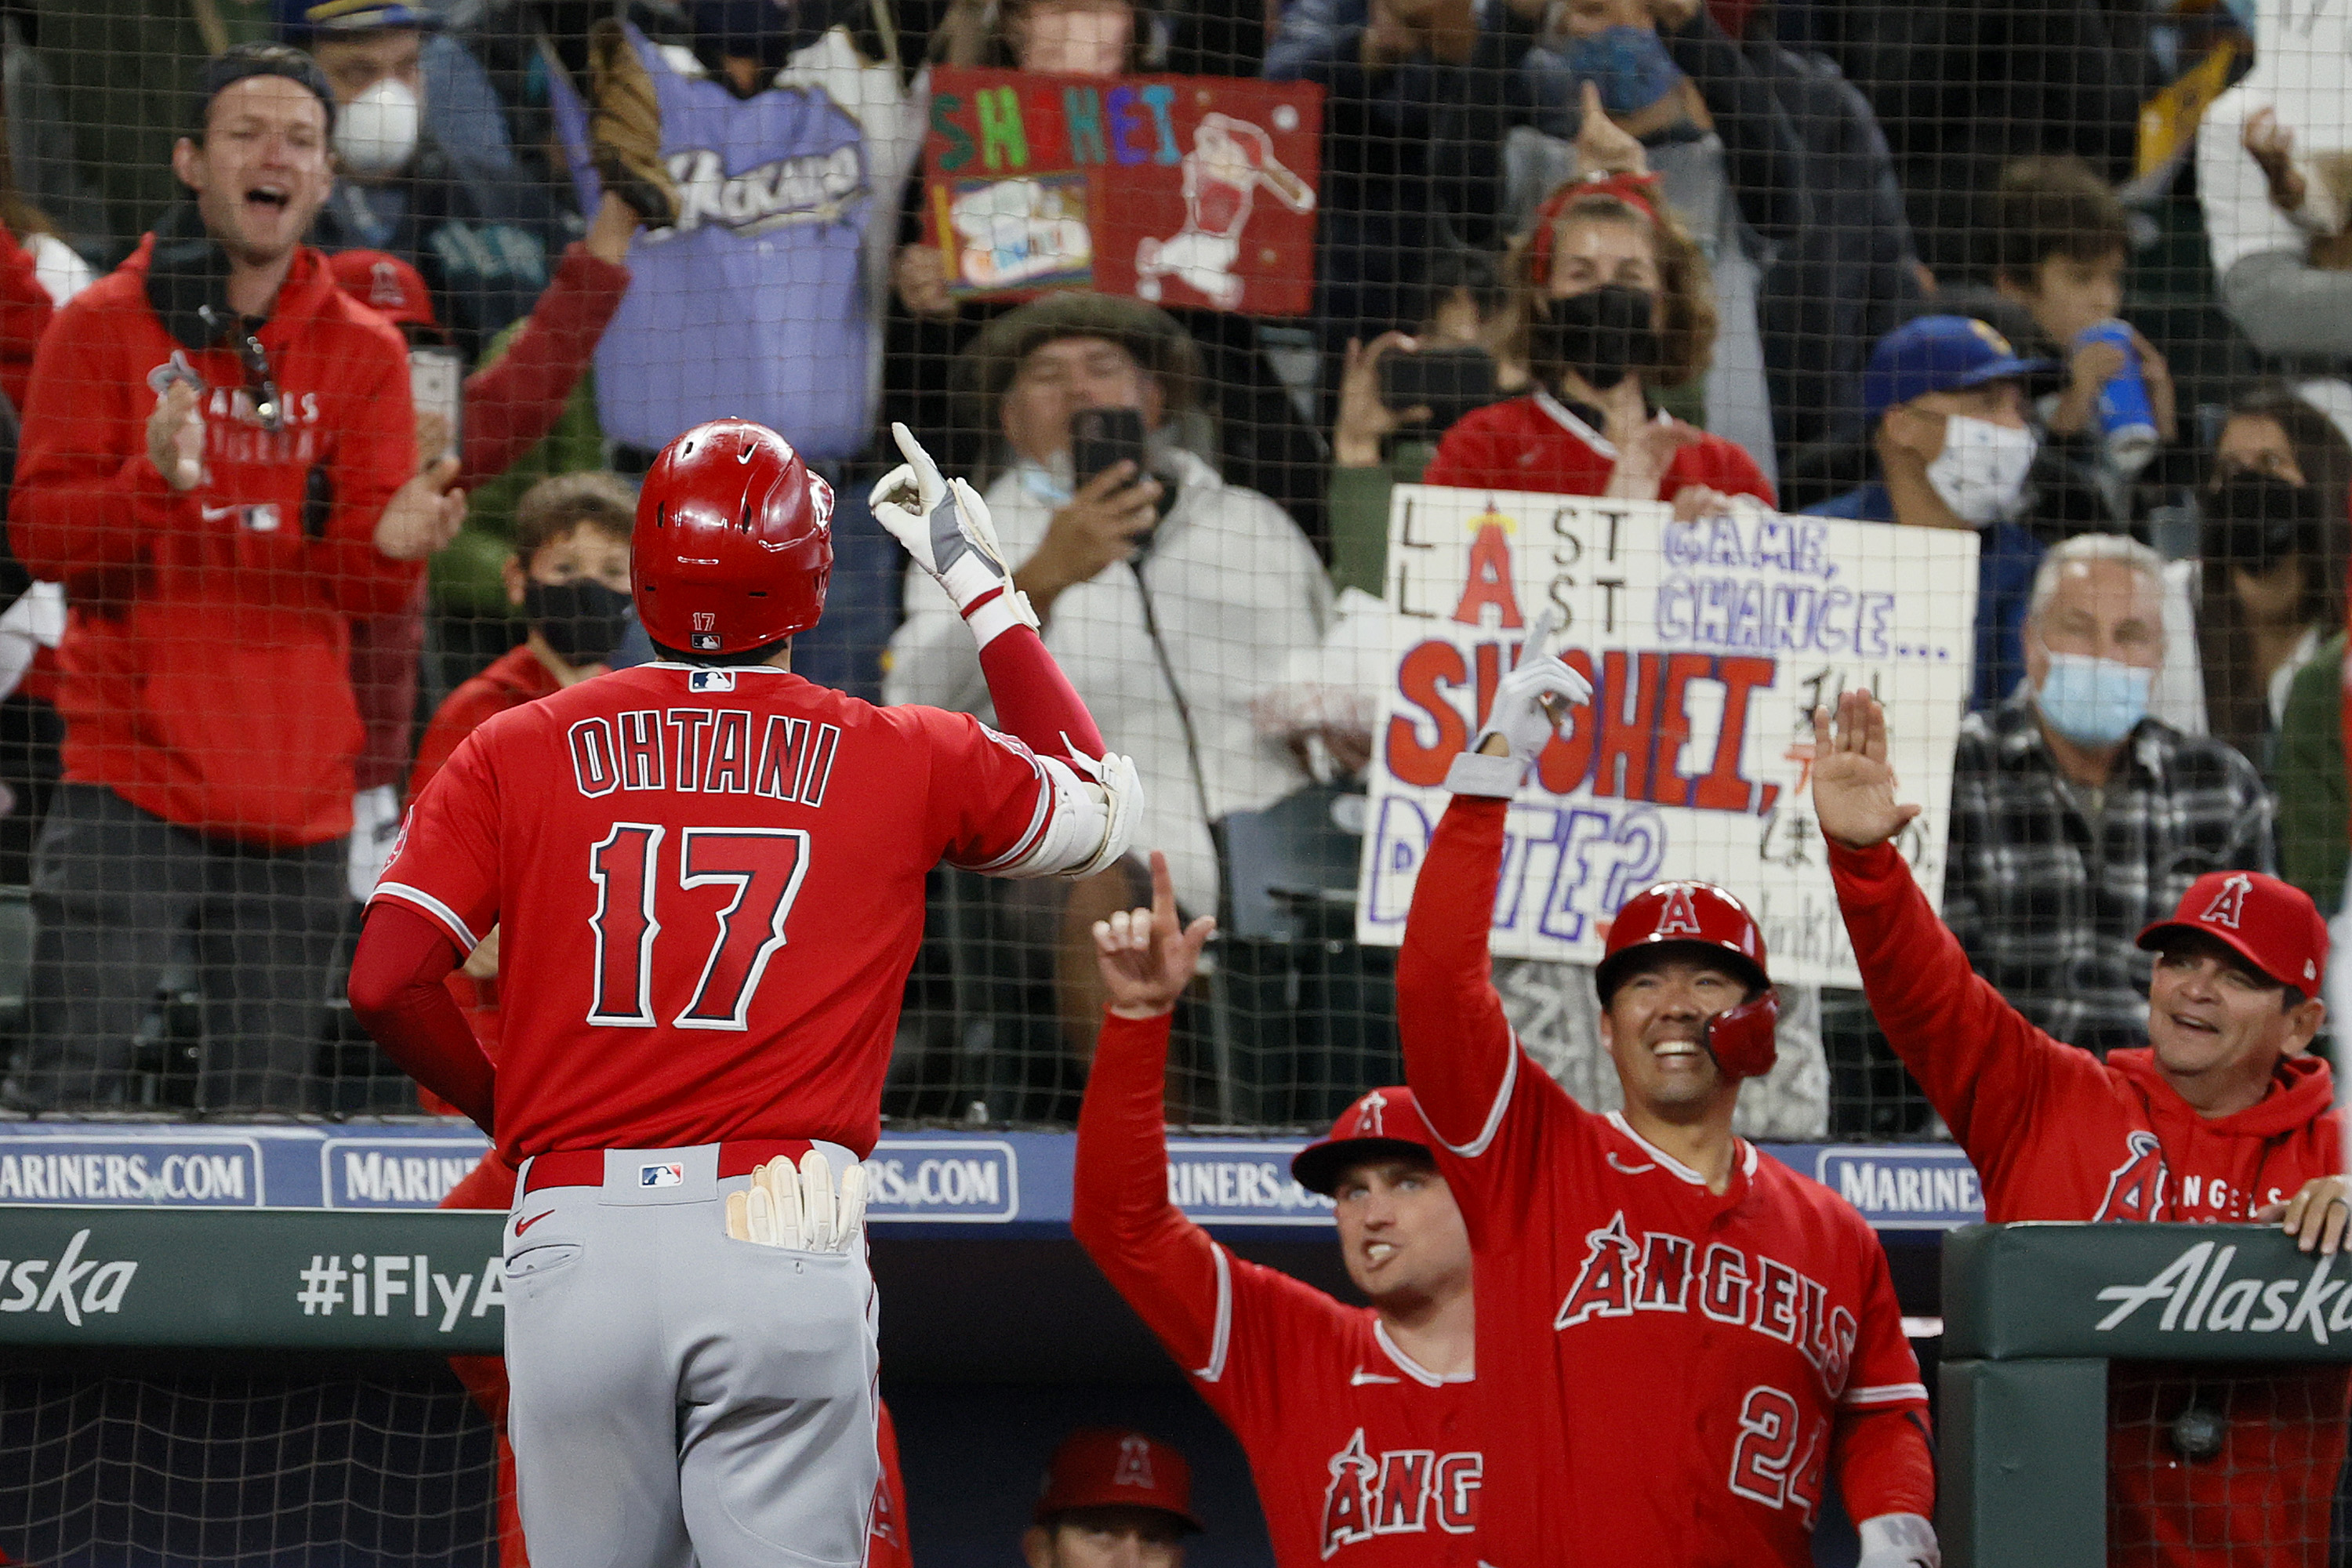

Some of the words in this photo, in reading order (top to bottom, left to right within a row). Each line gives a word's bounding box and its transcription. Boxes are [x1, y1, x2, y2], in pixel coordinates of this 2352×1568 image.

[931, 83, 1182, 171] SHOHEI
[692, 612, 716, 632] 17
[567, 707, 841, 808] OHTANI
[586, 821, 811, 1032] 17
[1370, 794, 1668, 942] DTE?
[1554, 1210, 1858, 1399] ANGELS
